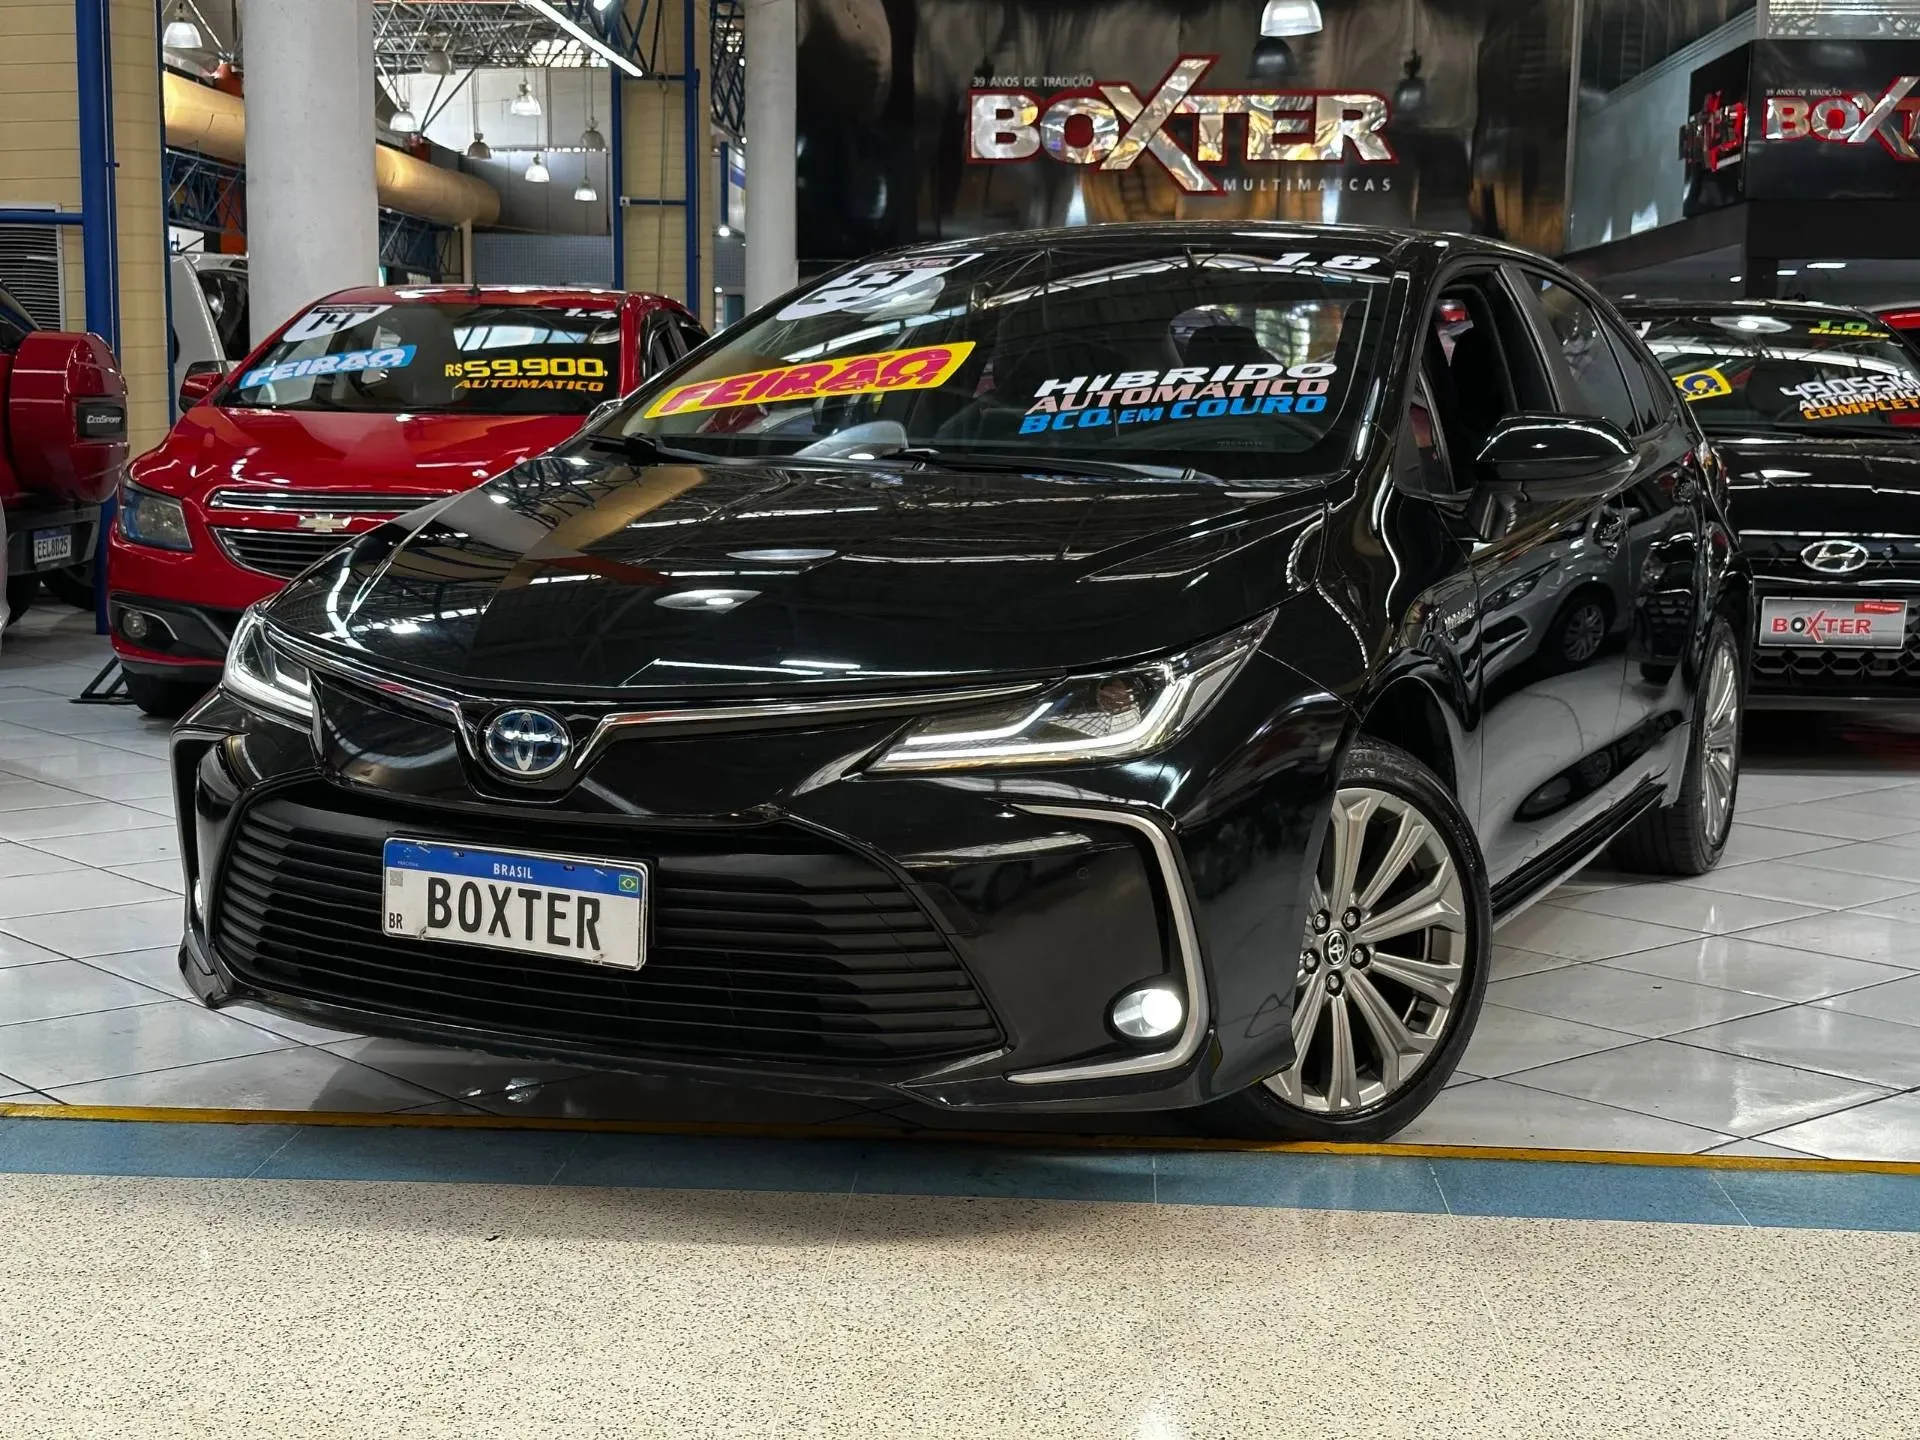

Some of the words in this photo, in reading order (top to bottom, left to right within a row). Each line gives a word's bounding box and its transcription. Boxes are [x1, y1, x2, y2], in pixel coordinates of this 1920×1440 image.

[972, 76, 986, 88] 39
[989, 76, 1020, 88] ANOS
[1024, 76, 1038, 88] DE
[1043, 74, 1094, 89] TRADIÇÃO
[968, 56, 1394, 196] BOXTER
[1223, 178, 1392, 192] MULTIMARCAS
[1271, 252, 1381, 270] 1.8
[564, 308, 618, 320] 1.4
[658, 348, 953, 413] FEIRÃO
[1116, 406, 1164, 425] EM
[1169, 395, 1328, 420] COURO
[1771, 609, 1873, 644] BOXTER
[493, 862, 533, 880] BRASIL
[388, 912, 403, 930] BR
[426, 876, 601, 951] BOXTER
